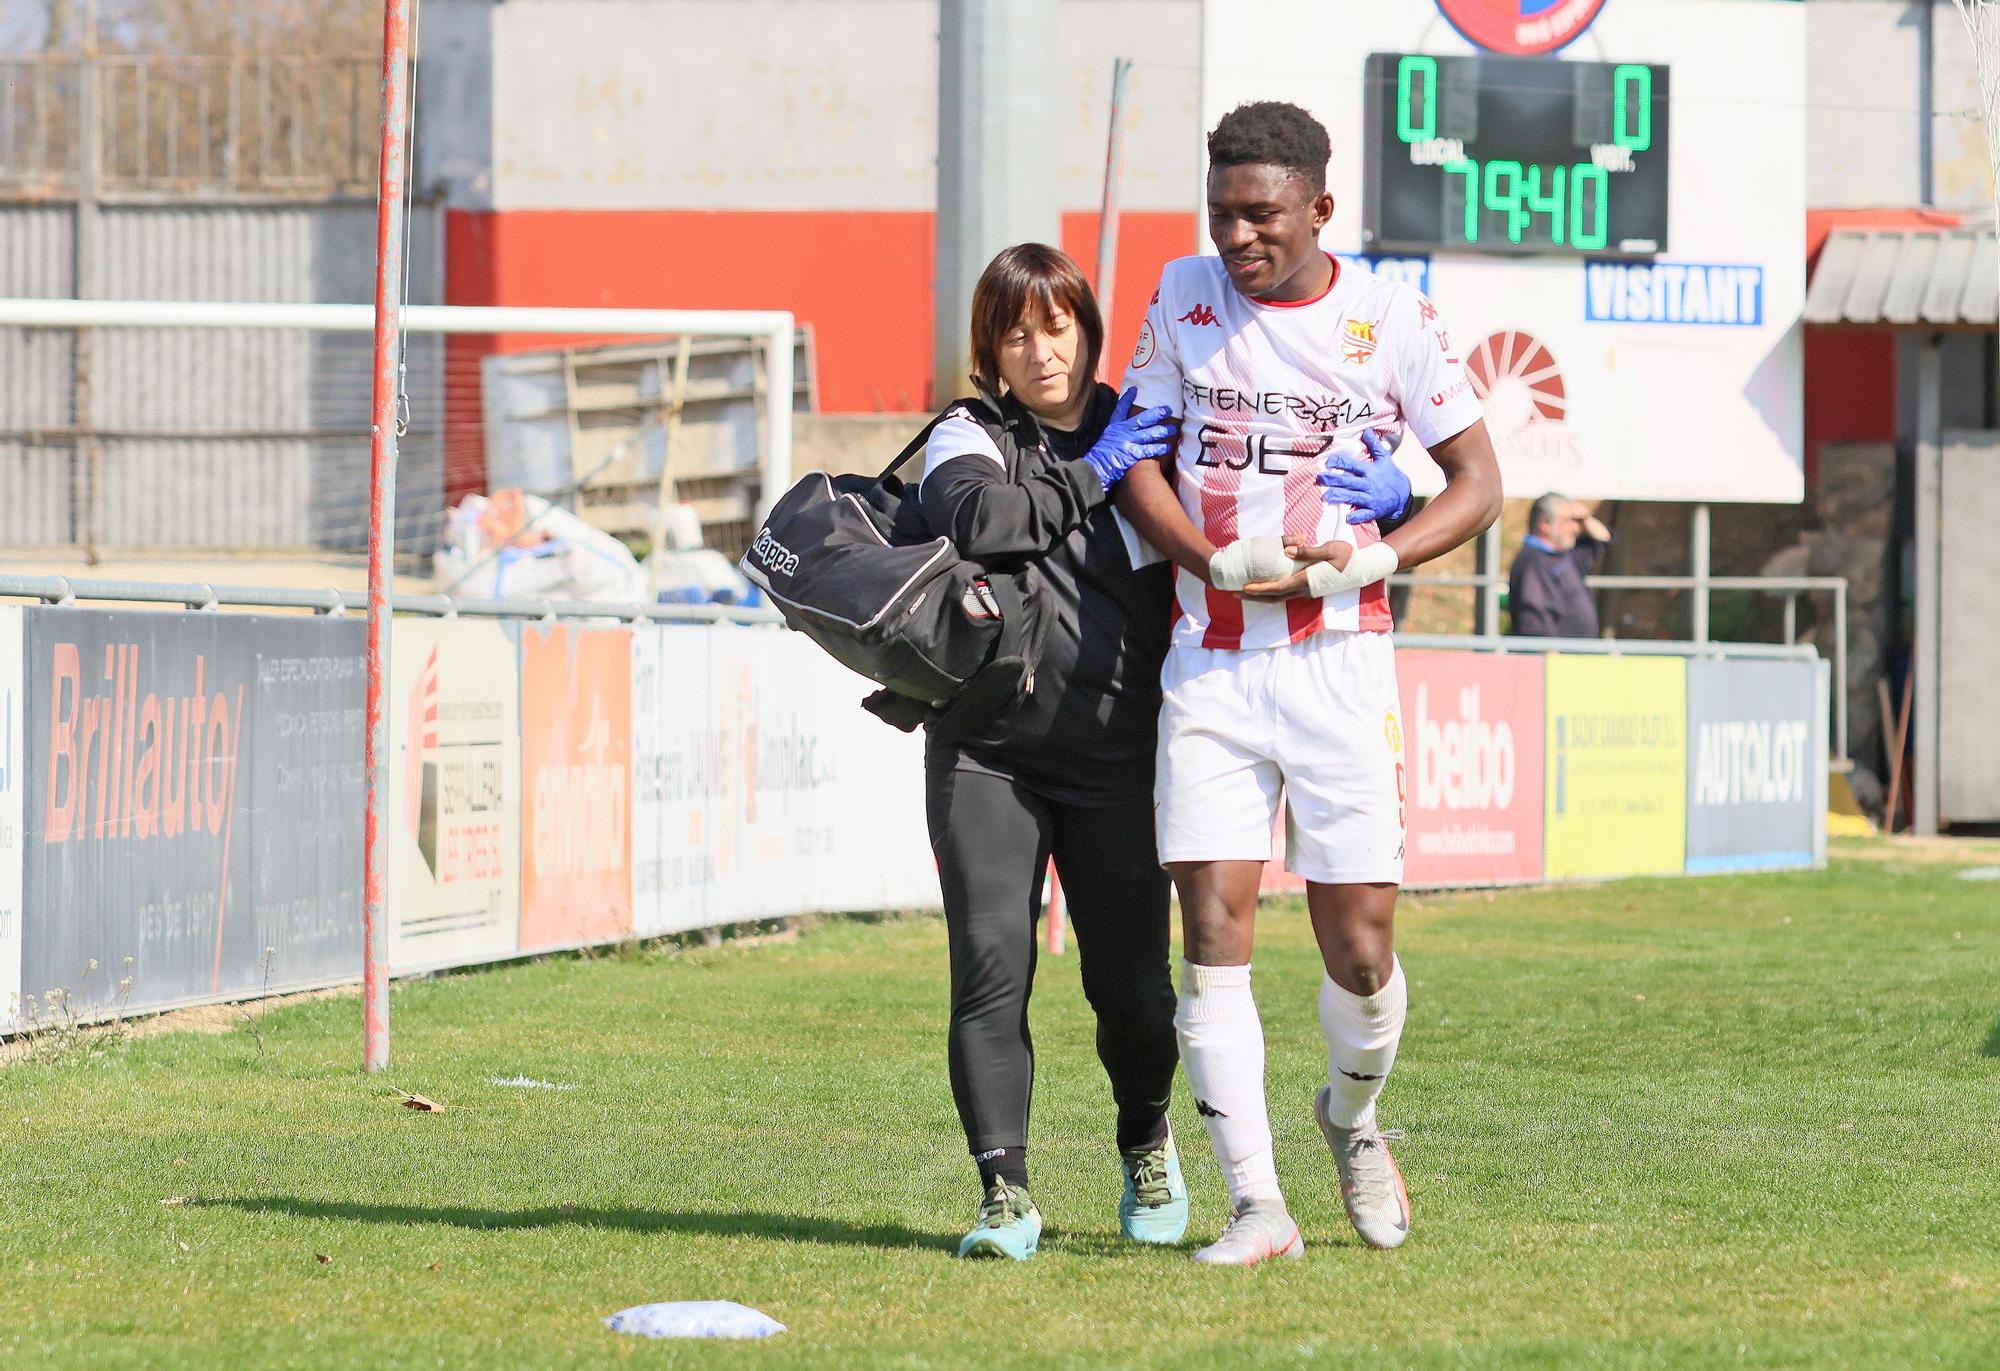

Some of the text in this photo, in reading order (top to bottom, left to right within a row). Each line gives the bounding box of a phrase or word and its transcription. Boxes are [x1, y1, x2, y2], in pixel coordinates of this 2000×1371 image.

[1397, 55, 1437, 143] 0
[1614, 64, 1651, 151] 0
[1443, 159, 1609, 250] 79:40
[1587, 265, 1761, 323] VISITANT
[45, 643, 229, 843] Brillauto
[1416, 682, 1515, 811] beibo
[1695, 720, 1808, 806] AUTOLOT
